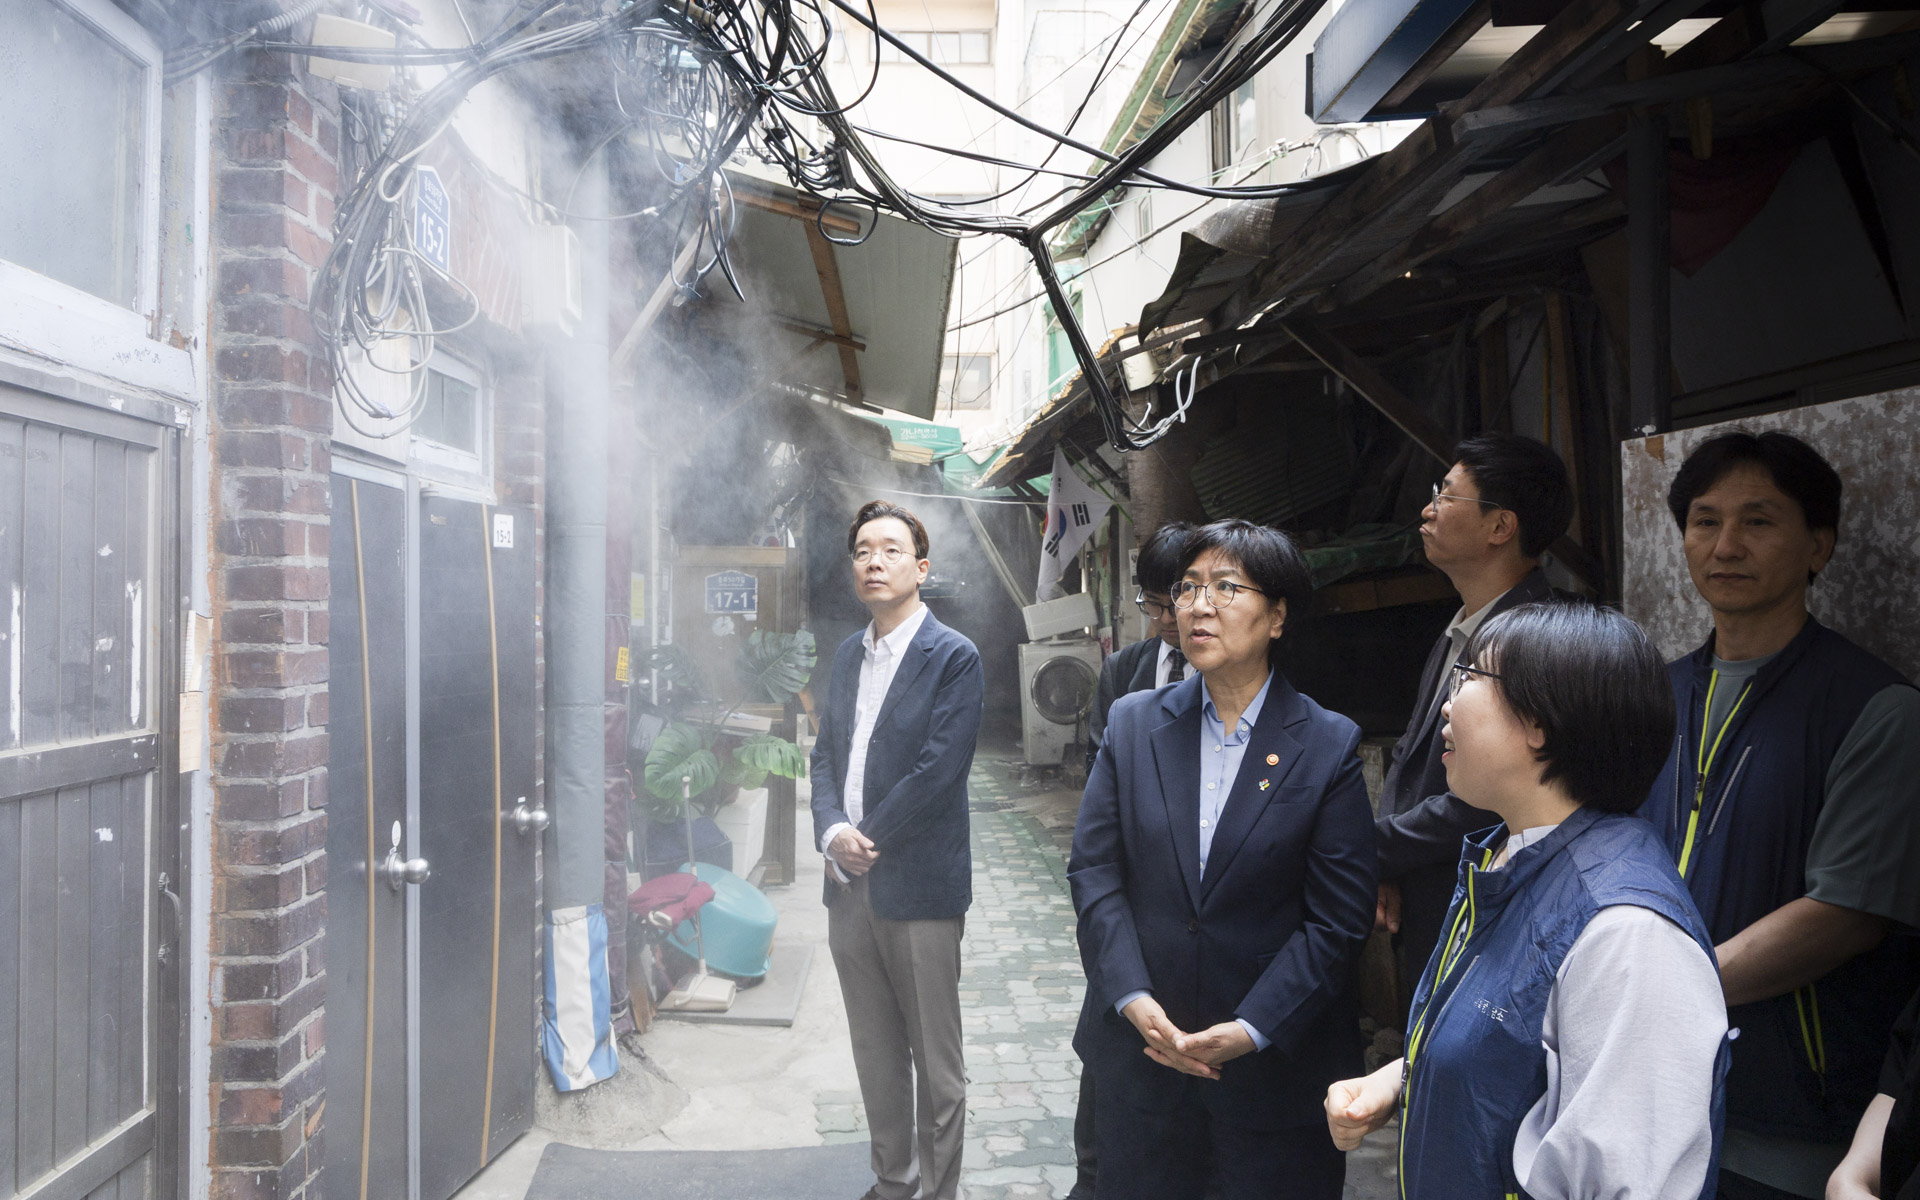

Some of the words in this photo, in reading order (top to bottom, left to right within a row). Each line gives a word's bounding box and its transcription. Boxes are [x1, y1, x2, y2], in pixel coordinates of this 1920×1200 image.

[421, 212, 444, 263] 15-2
[496, 529, 511, 543] 15-2
[714, 592, 747, 608] 17-1
